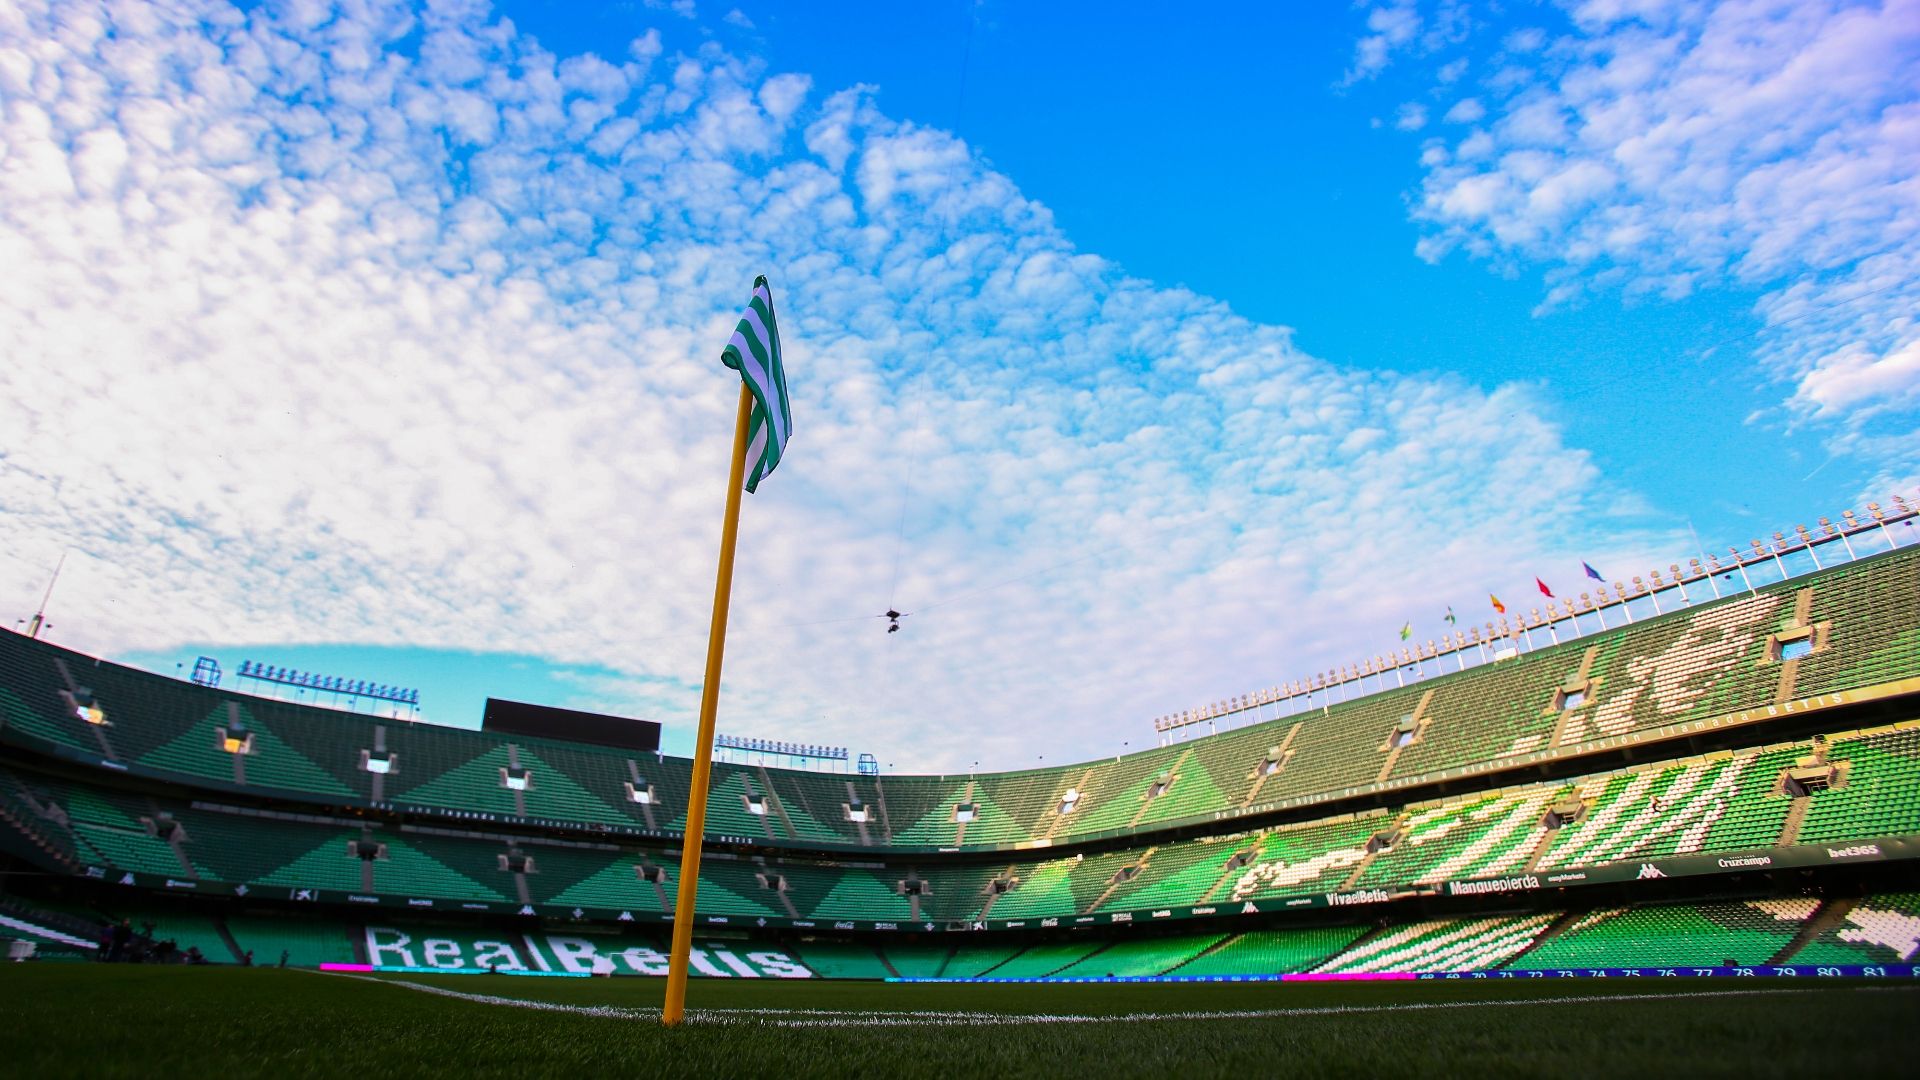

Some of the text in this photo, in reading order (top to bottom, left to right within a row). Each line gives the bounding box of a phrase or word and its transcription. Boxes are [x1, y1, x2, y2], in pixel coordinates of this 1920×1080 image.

[1529, 748, 1559, 762] una
[1575, 733, 1642, 754] pasión
[1767, 692, 1844, 717] BETIS
[720, 835, 754, 845] BETIS
[1827, 844, 1880, 858] bet365
[1718, 857, 1771, 868] Cruzcampo
[1471, 971, 1487, 979] 70
[1499, 971, 1513, 979] 71
[1527, 970, 1544, 979] 72
[1557, 970, 1575, 978] 73
[1621, 969, 1641, 977] 75
[1656, 969, 1677, 977] 76
[1693, 968, 1713, 977] 77
[1731, 967, 1755, 977] 78
[1773, 967, 1797, 977] 79
[1817, 967, 1842, 977] 80
[1863, 966, 1888, 977] 81
